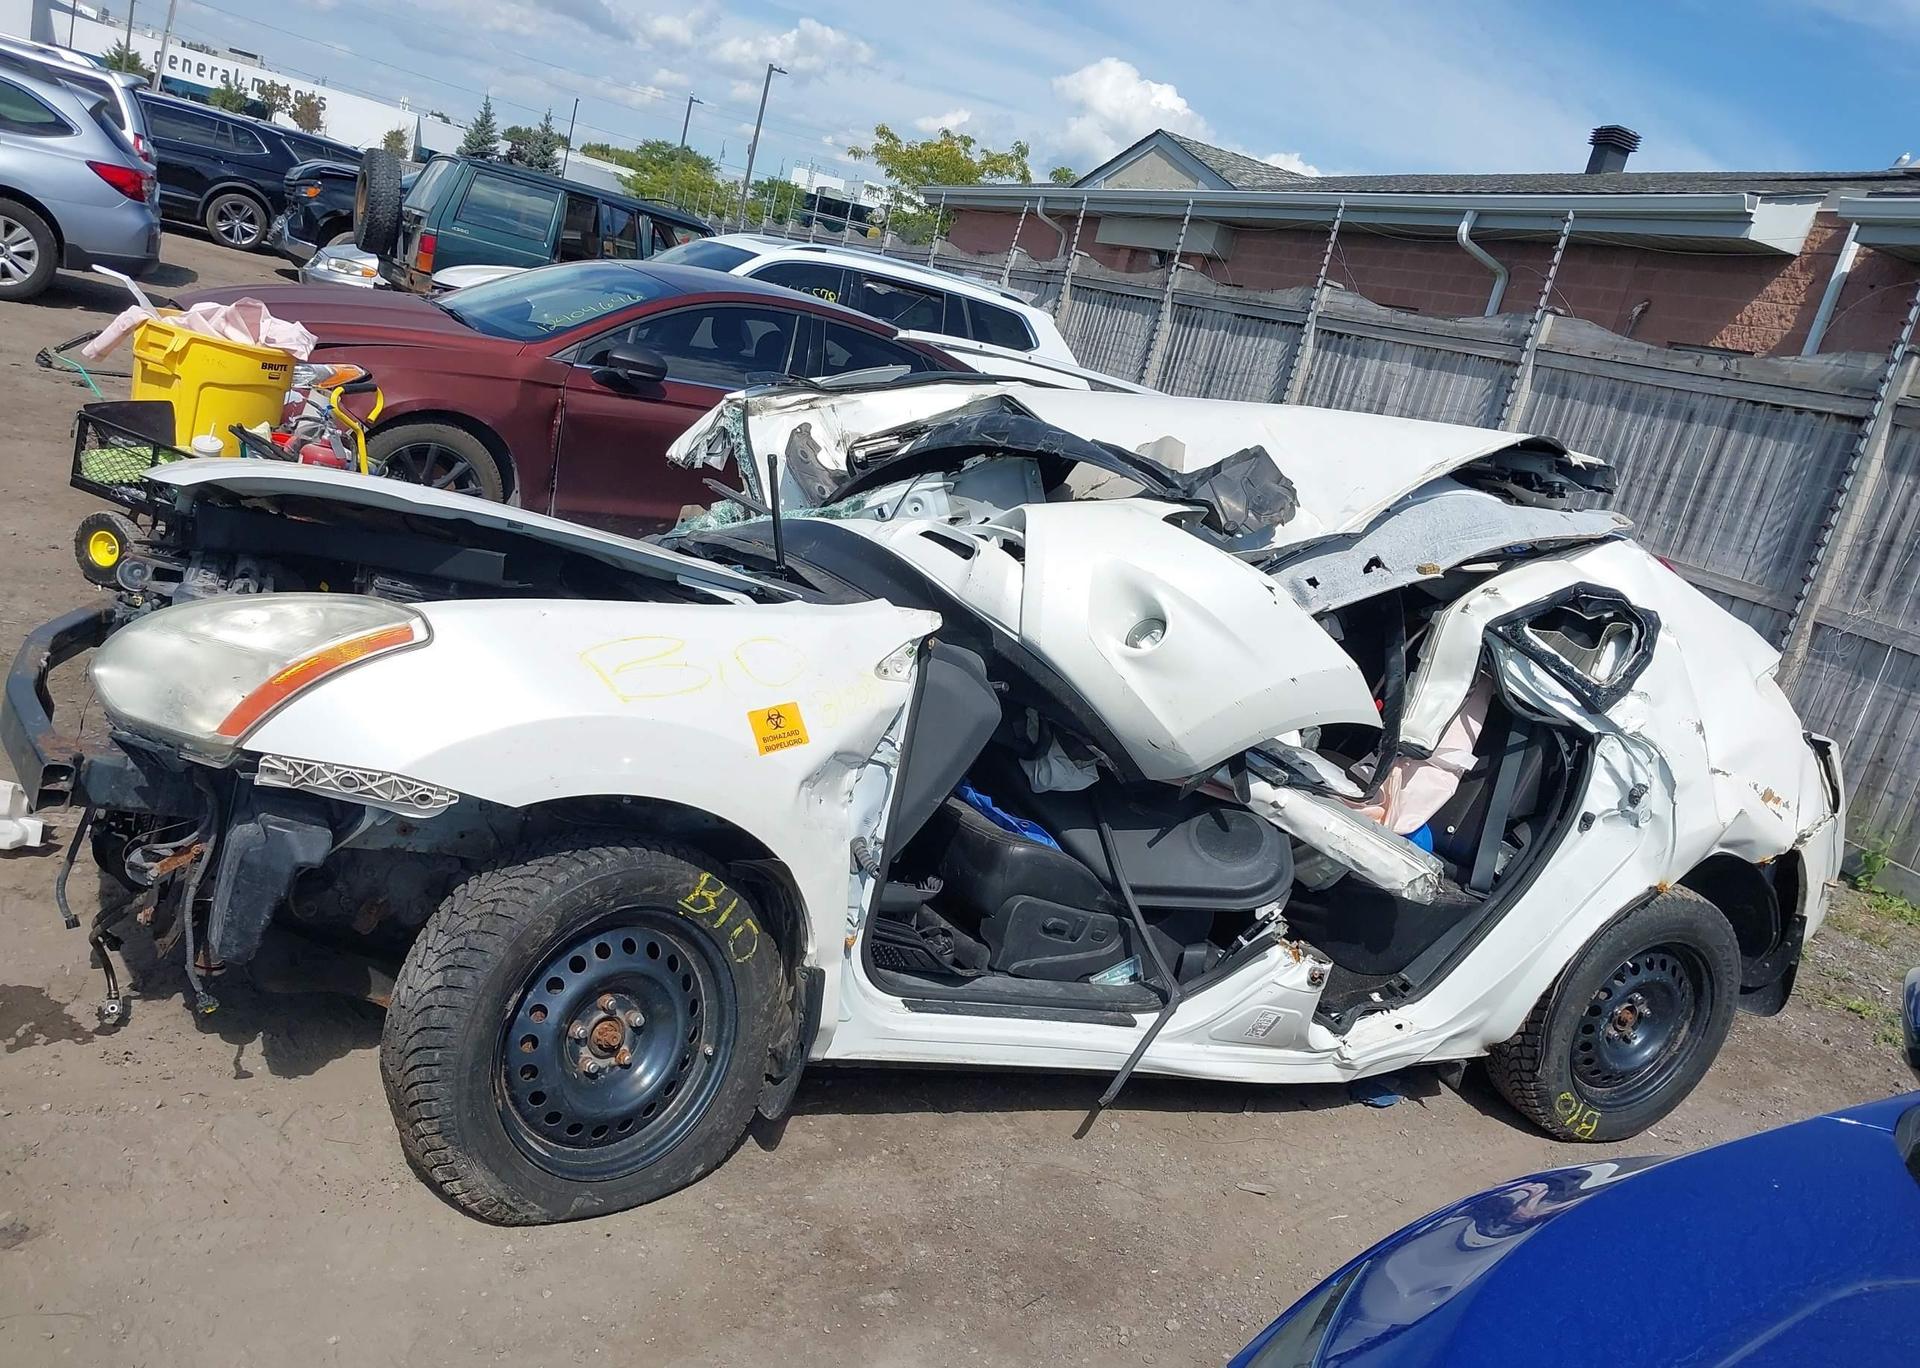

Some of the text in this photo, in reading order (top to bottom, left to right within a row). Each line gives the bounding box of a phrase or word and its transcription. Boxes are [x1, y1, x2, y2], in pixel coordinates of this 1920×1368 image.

[261, 362, 288, 372] BRUTE
[762, 729, 800, 744] BIOHAZARD
[764, 737, 803, 752] BIOPELIGRO
